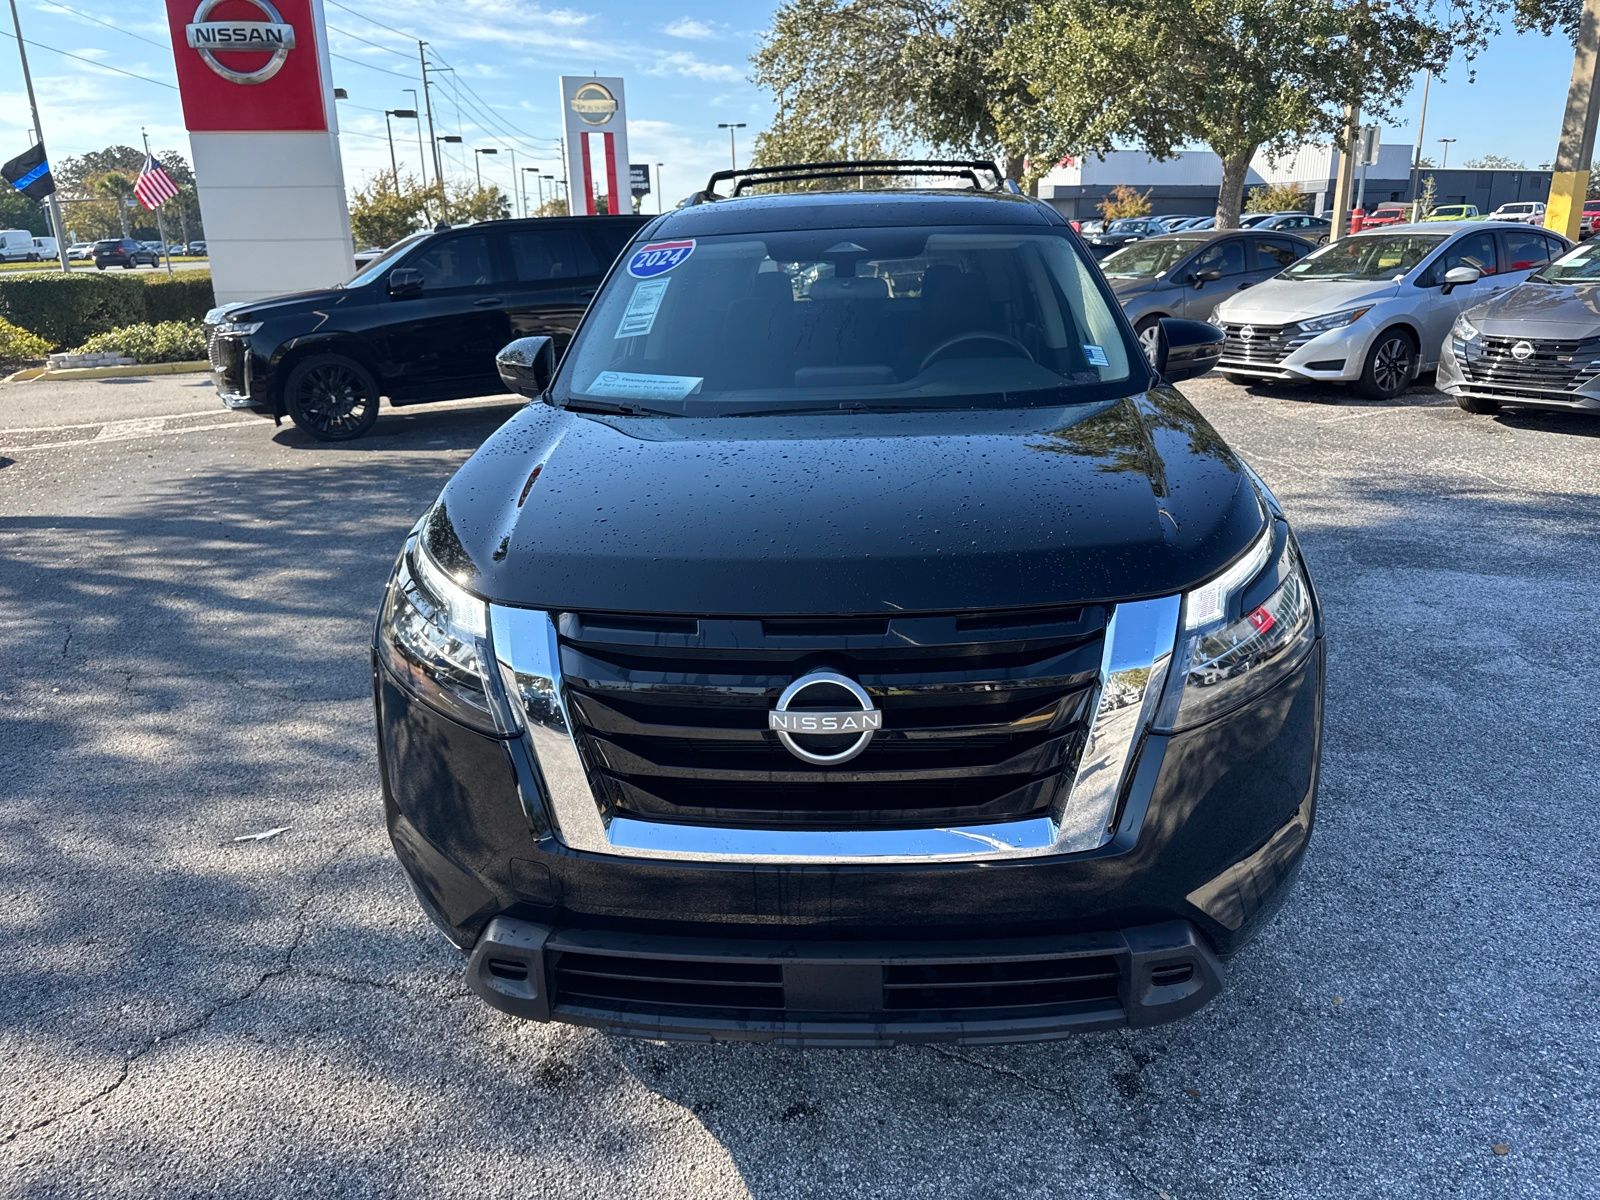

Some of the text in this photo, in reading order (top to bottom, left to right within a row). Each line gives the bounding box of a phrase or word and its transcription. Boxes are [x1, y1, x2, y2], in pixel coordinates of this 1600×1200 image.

[195, 28, 283, 43] NISSAN
[633, 248, 685, 269] 2024
[772, 714, 878, 730] NISSAN
